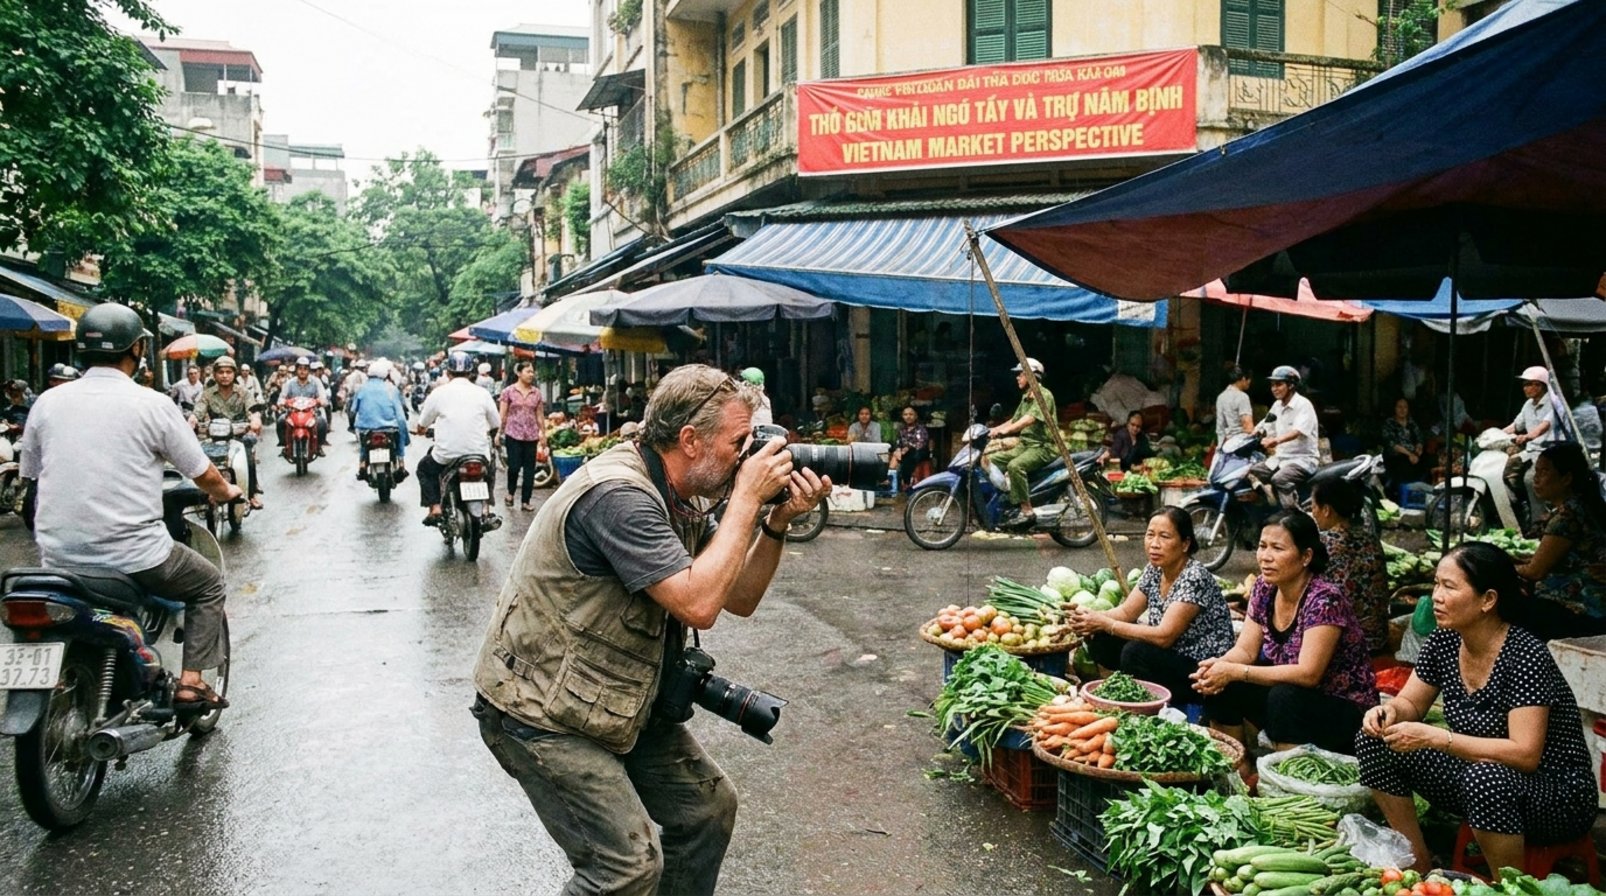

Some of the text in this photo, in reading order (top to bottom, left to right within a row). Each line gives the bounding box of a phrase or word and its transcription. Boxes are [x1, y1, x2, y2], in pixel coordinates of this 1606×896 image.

[842, 123, 1144, 164] VIETNAM MARKET PERSPECTIVE
